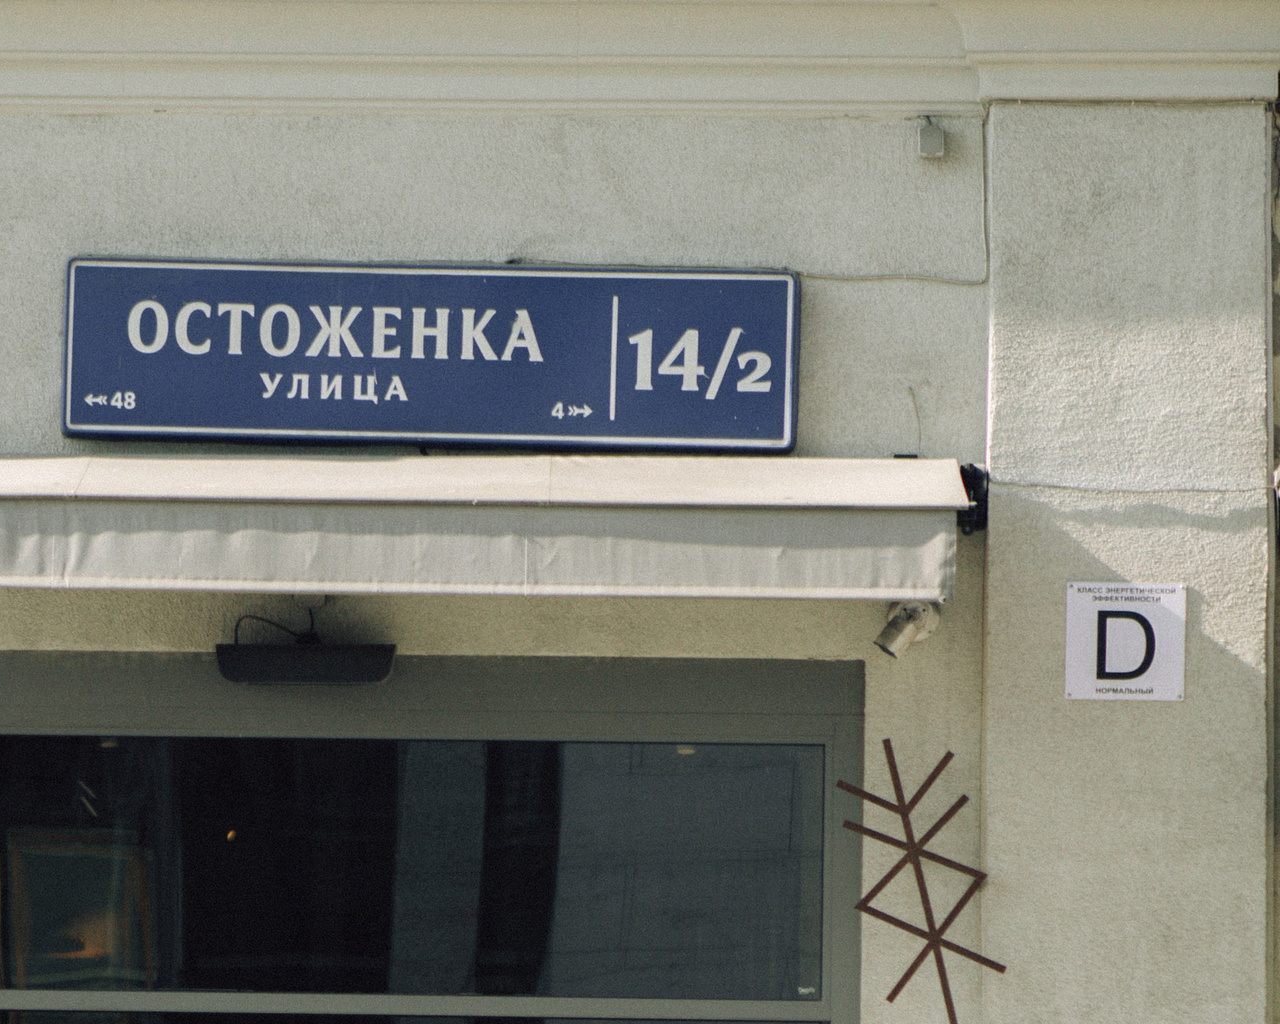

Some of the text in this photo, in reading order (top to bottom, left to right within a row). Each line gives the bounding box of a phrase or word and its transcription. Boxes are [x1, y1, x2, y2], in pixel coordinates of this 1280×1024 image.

[127, 299, 544, 363] ОСТОЖЕНКА
[628, 326, 772, 400] 14/2
[110, 391, 136, 409] 48
[259, 372, 408, 405] УЛИЦА
[551, 402, 565, 420] 4
[1077, 587, 1176, 595] КЛАСС ЭНЕРГЕТИЧЕСКОЙ
[1096, 610, 1156, 680] D
[1096, 686, 1154, 695] НОРМАЛЬНЫЙ
